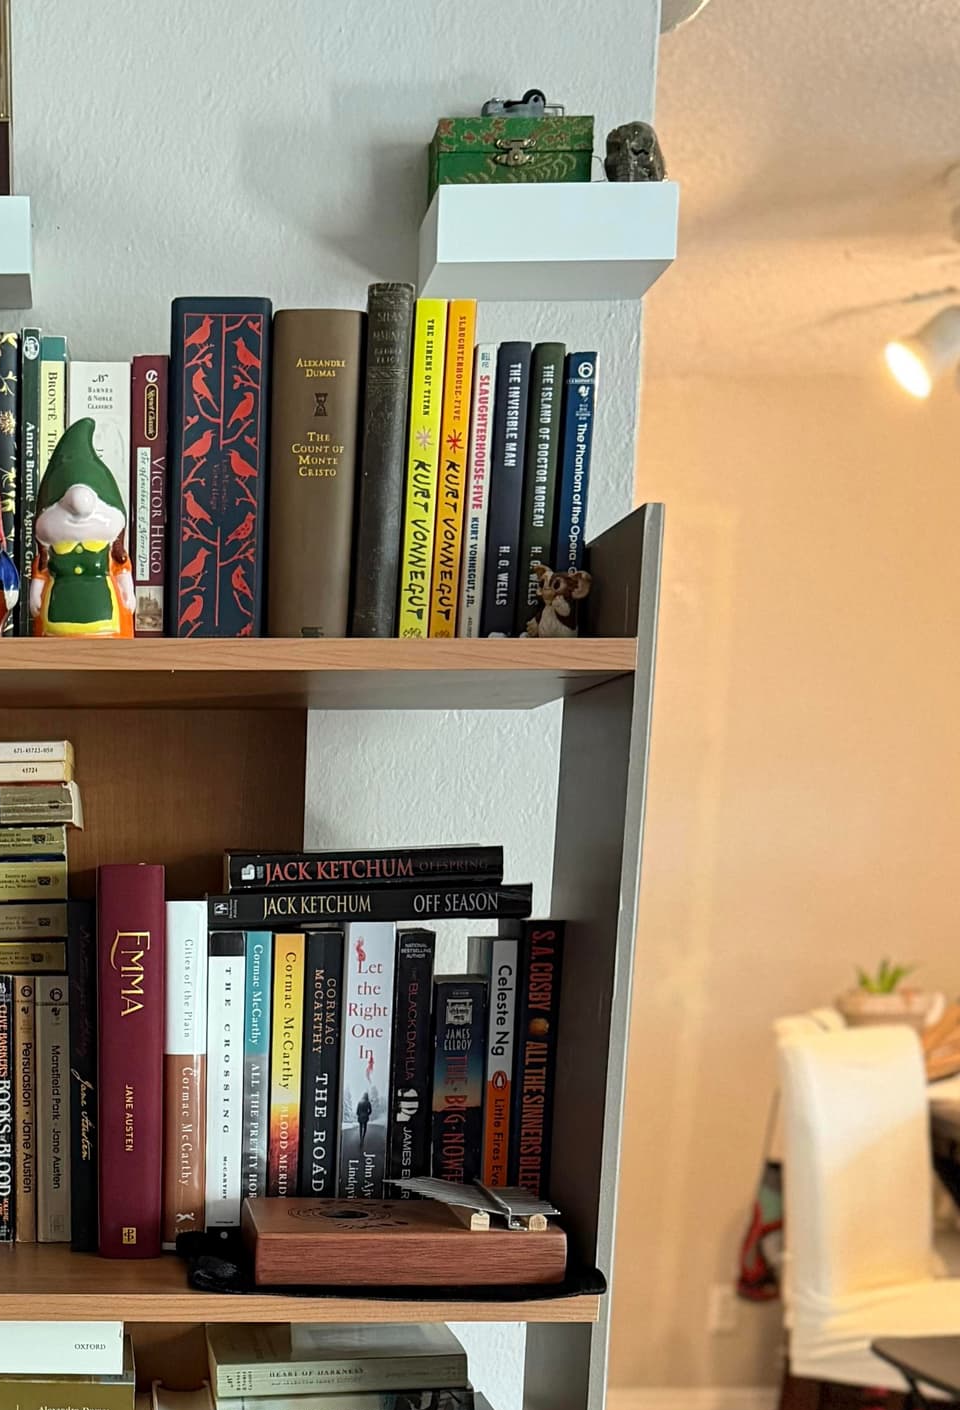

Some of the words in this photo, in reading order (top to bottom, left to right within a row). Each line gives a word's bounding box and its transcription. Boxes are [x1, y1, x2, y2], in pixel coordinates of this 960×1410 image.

[471, 374, 490, 510] SLAUGHTERHOUSE-FIVE
[263, 897, 298, 919] JACK
[301, 896, 371, 914] KETCHUM
[414, 894, 440, 912] OFF
[445, 892, 498, 912] SEASON
[497, 965, 513, 1026] Celeste
[491, 1032, 510, 1056] Ng
